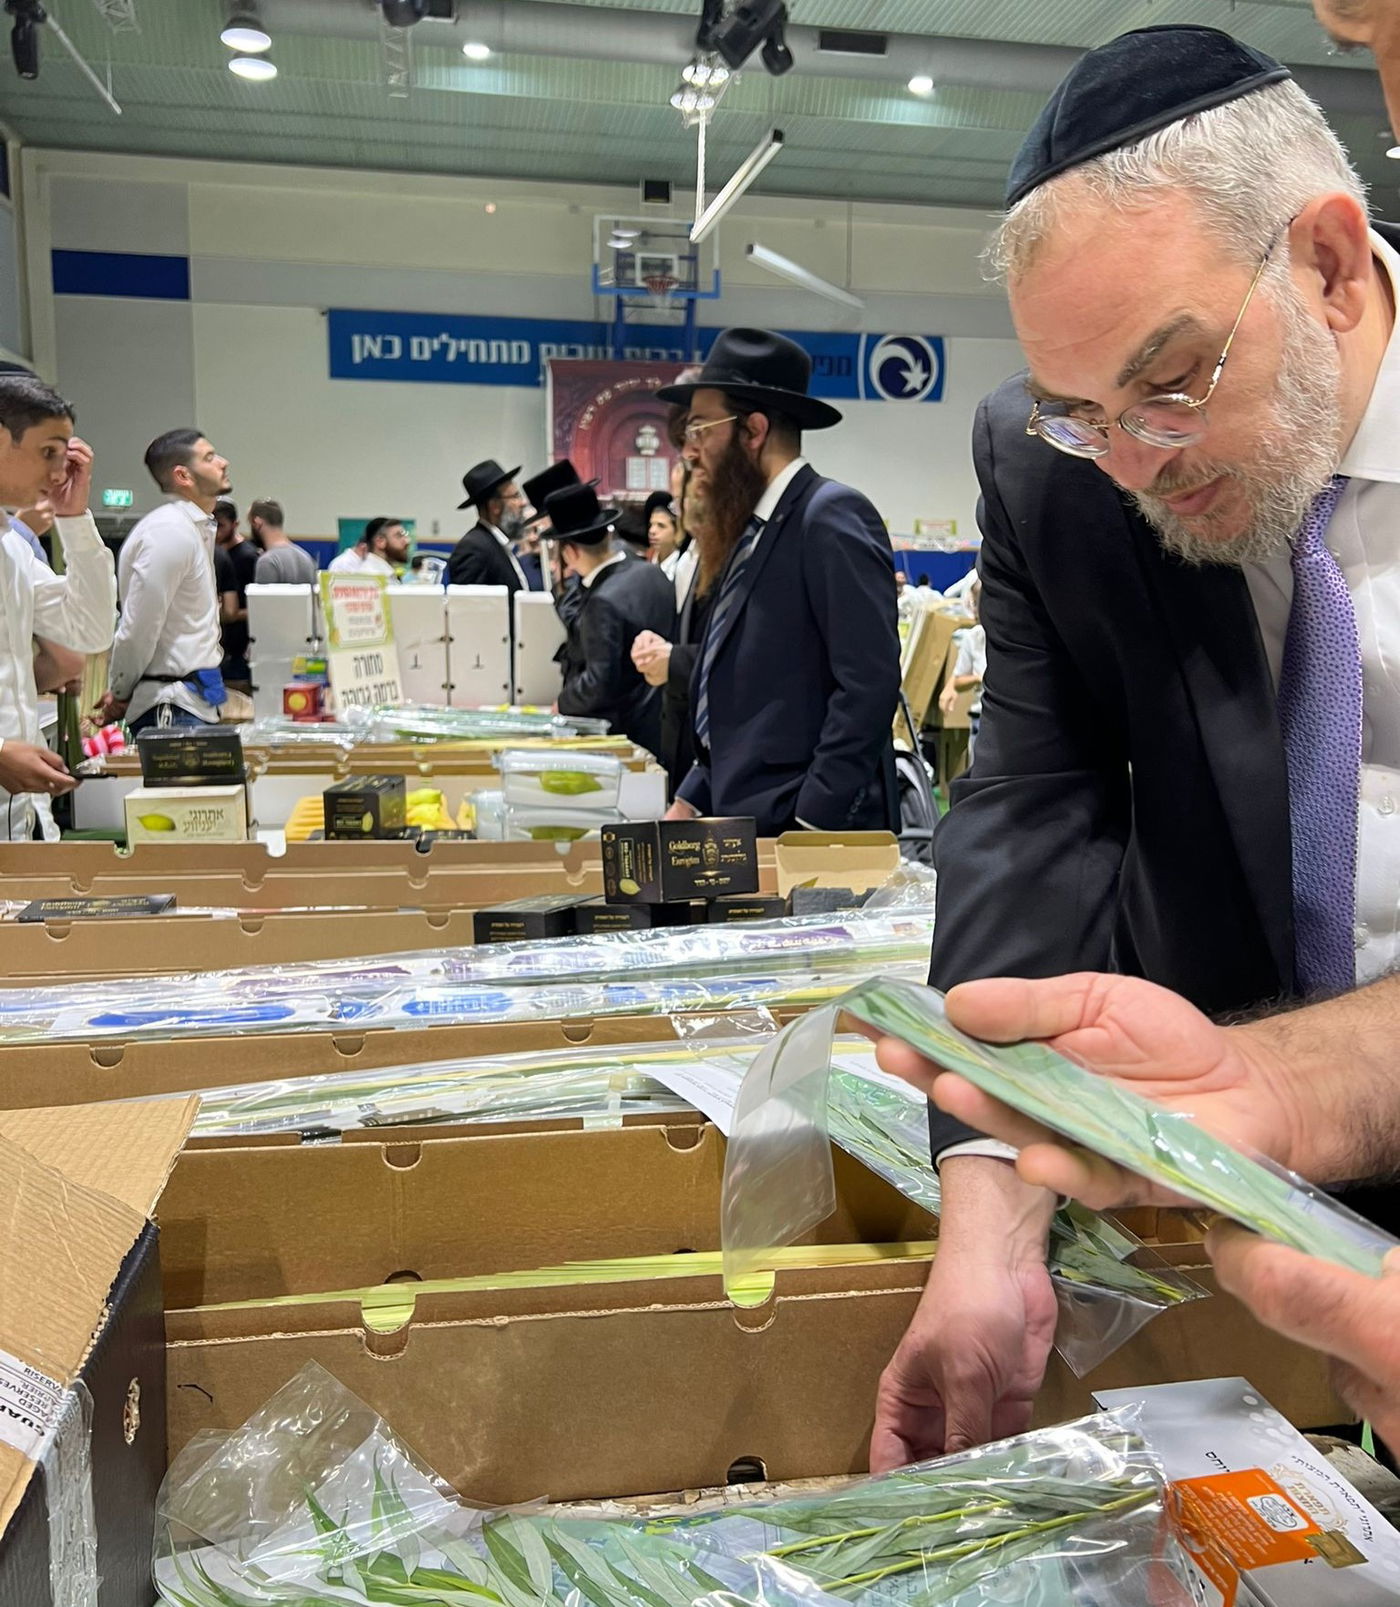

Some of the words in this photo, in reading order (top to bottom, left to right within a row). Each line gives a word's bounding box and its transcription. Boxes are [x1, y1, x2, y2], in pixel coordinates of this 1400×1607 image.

[351, 333, 402, 364] כאן
[410, 333, 531, 364] מתחילים
[353, 653, 383, 679] סחורה
[188, 808, 224, 823] אתרוגי
[668, 839, 701, 852] Goldberg
[1294, 1480, 1330, 1516] תפארת
